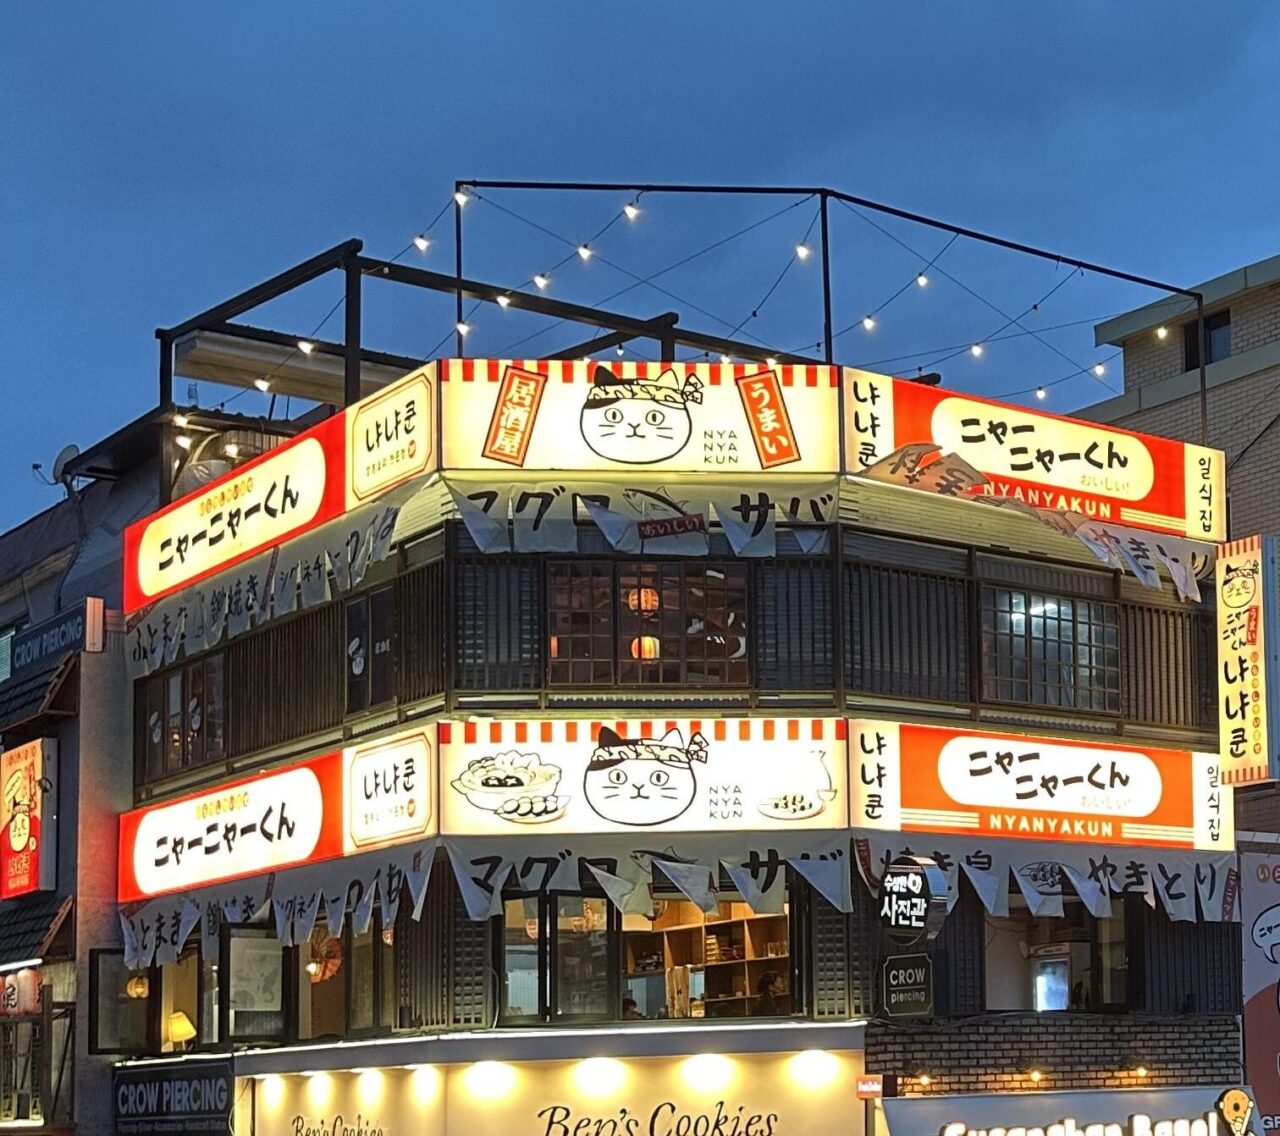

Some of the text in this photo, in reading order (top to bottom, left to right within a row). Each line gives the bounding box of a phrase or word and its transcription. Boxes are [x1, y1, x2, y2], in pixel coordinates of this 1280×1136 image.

[366, 400, 416, 452] 냐냐쿤
[492, 378, 537, 457] 居酒屋
[704, 430, 738, 441] NYA
[751, 383, 791, 456] うまい
[704, 442, 738, 453] NYA
[704, 454, 739, 465] KUN
[983, 481, 1112, 519] NYANYAKUN
[1199, 456, 1213, 533] 일식집
[157, 475, 300, 572] ニャーニャーくん
[1223, 655, 1251, 759] 냐냐쿤
[364, 758, 416, 800] 냐냐쿤
[709, 785, 743, 795] NYA
[860, 731, 888, 820] 냐냐쿤
[709, 797, 743, 807] NYA
[709, 810, 743, 820] KUN
[1206, 765, 1221, 842] 일식집
[154, 802, 296, 868] ニャーニャーくん
[989, 813, 1114, 838] NYANYAKUN
[881, 894, 927, 927] 사진관
[890, 968, 926, 986] CROW
[890, 988, 926, 1005] piercing
[118, 1078, 228, 1115] CROW PIERCING
